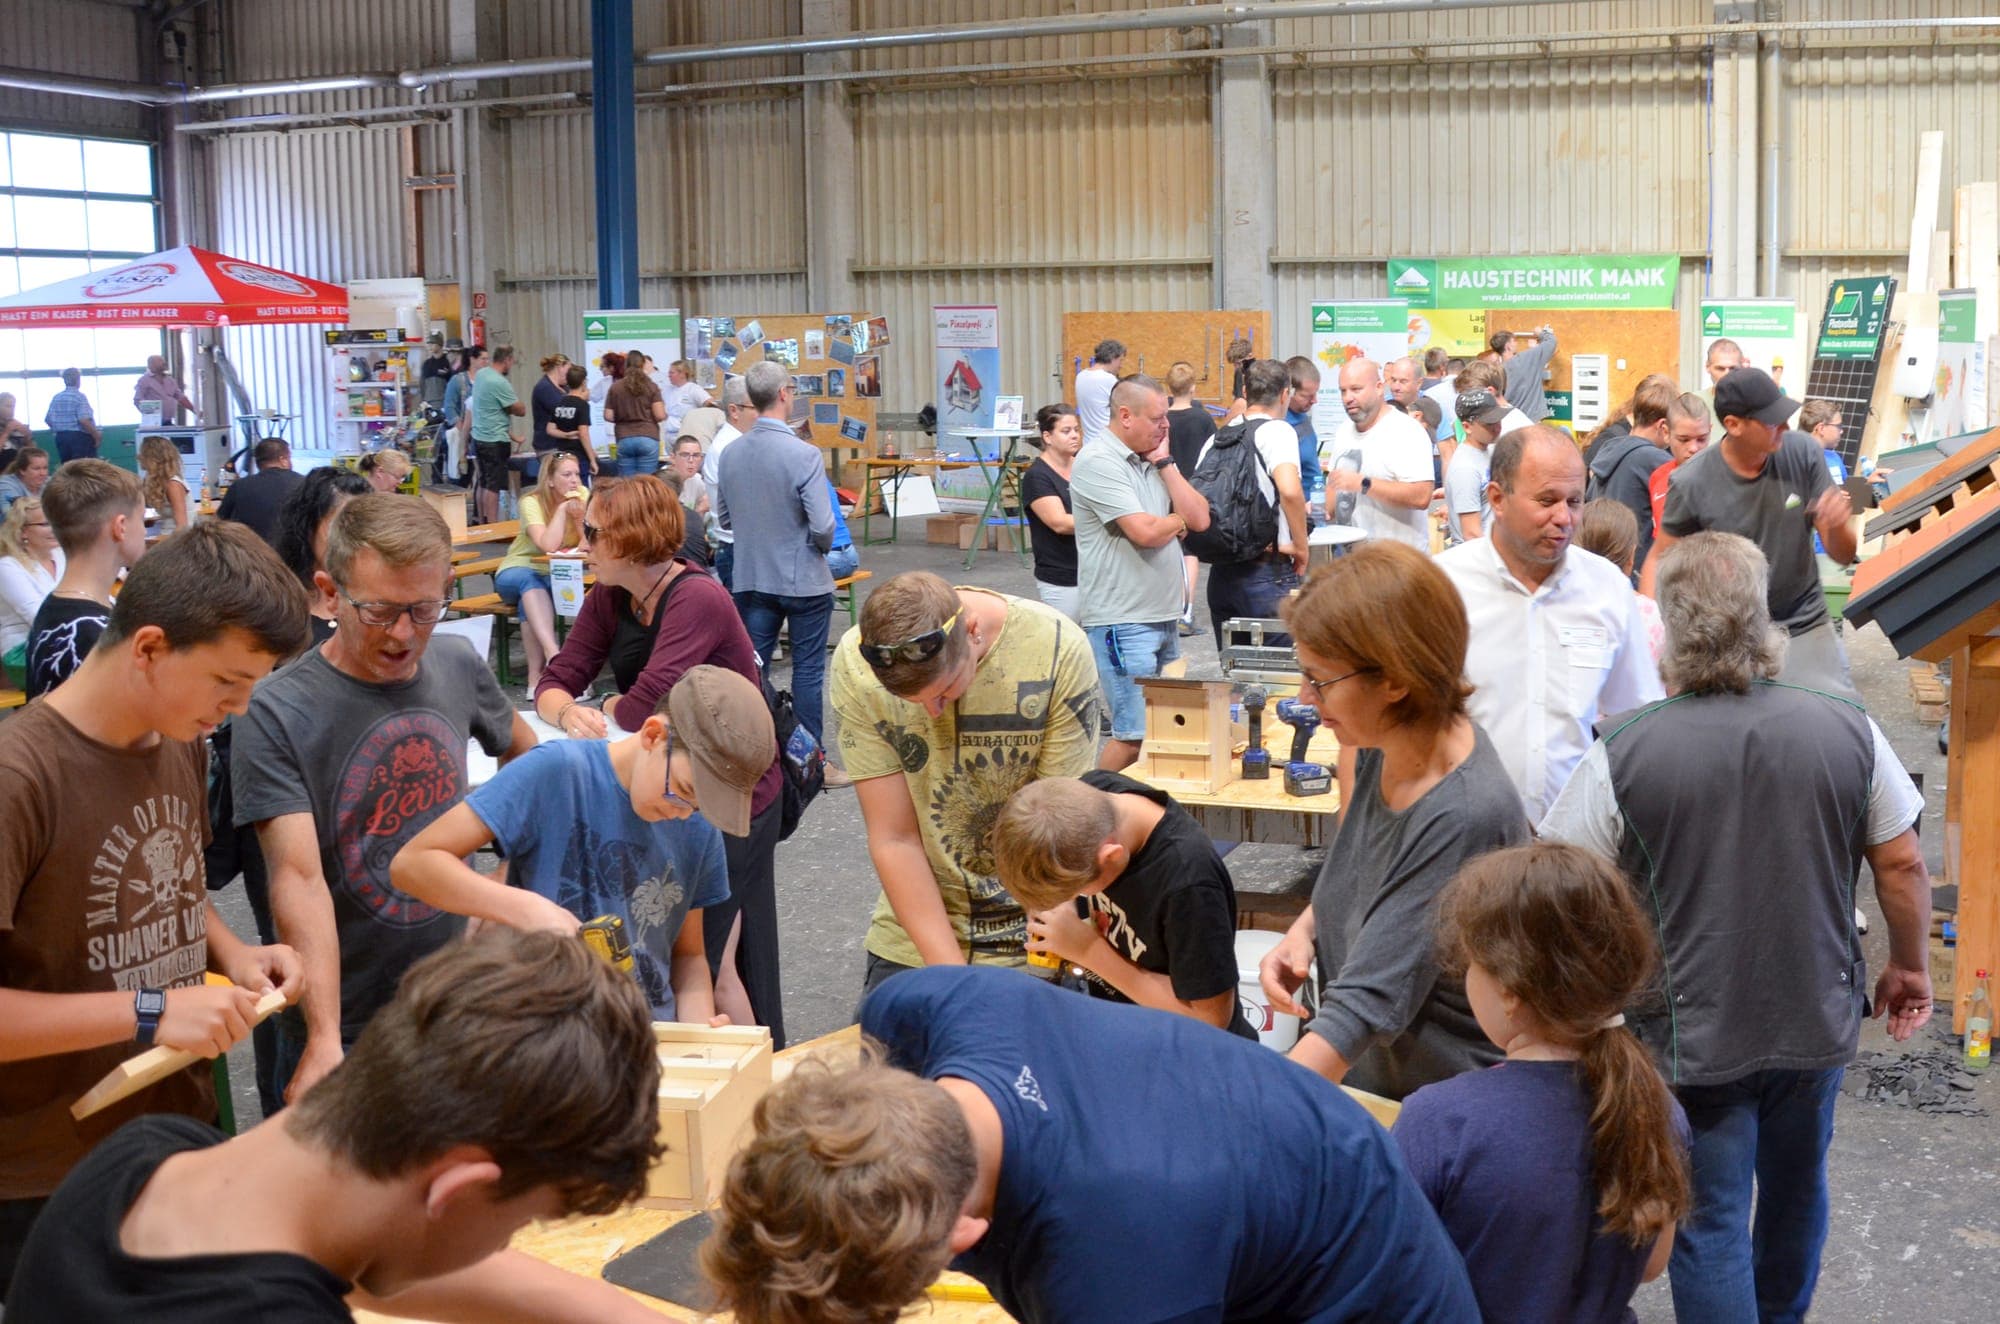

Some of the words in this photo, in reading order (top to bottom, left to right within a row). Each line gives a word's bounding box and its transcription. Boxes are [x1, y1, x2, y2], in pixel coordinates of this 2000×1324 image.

[1443, 268, 1594, 288] HAUSTECHNIK
[1600, 268, 1666, 287] MANK
[30, 311, 49, 320] EIN
[52, 309, 89, 320] KAISER
[96, 309, 119, 319] BIST
[121, 309, 140, 318] EIN
[143, 308, 179, 318] KAISER
[256, 307, 276, 317] HAST
[277, 306, 291, 316] EIN
[292, 306, 317, 316] KAISER
[321, 305, 337, 316] BIST
[86, 824, 138, 929] MASTER
[133, 798, 157, 834] OF
[162, 794, 188, 830] THE
[87, 914, 178, 972] SUMMER
